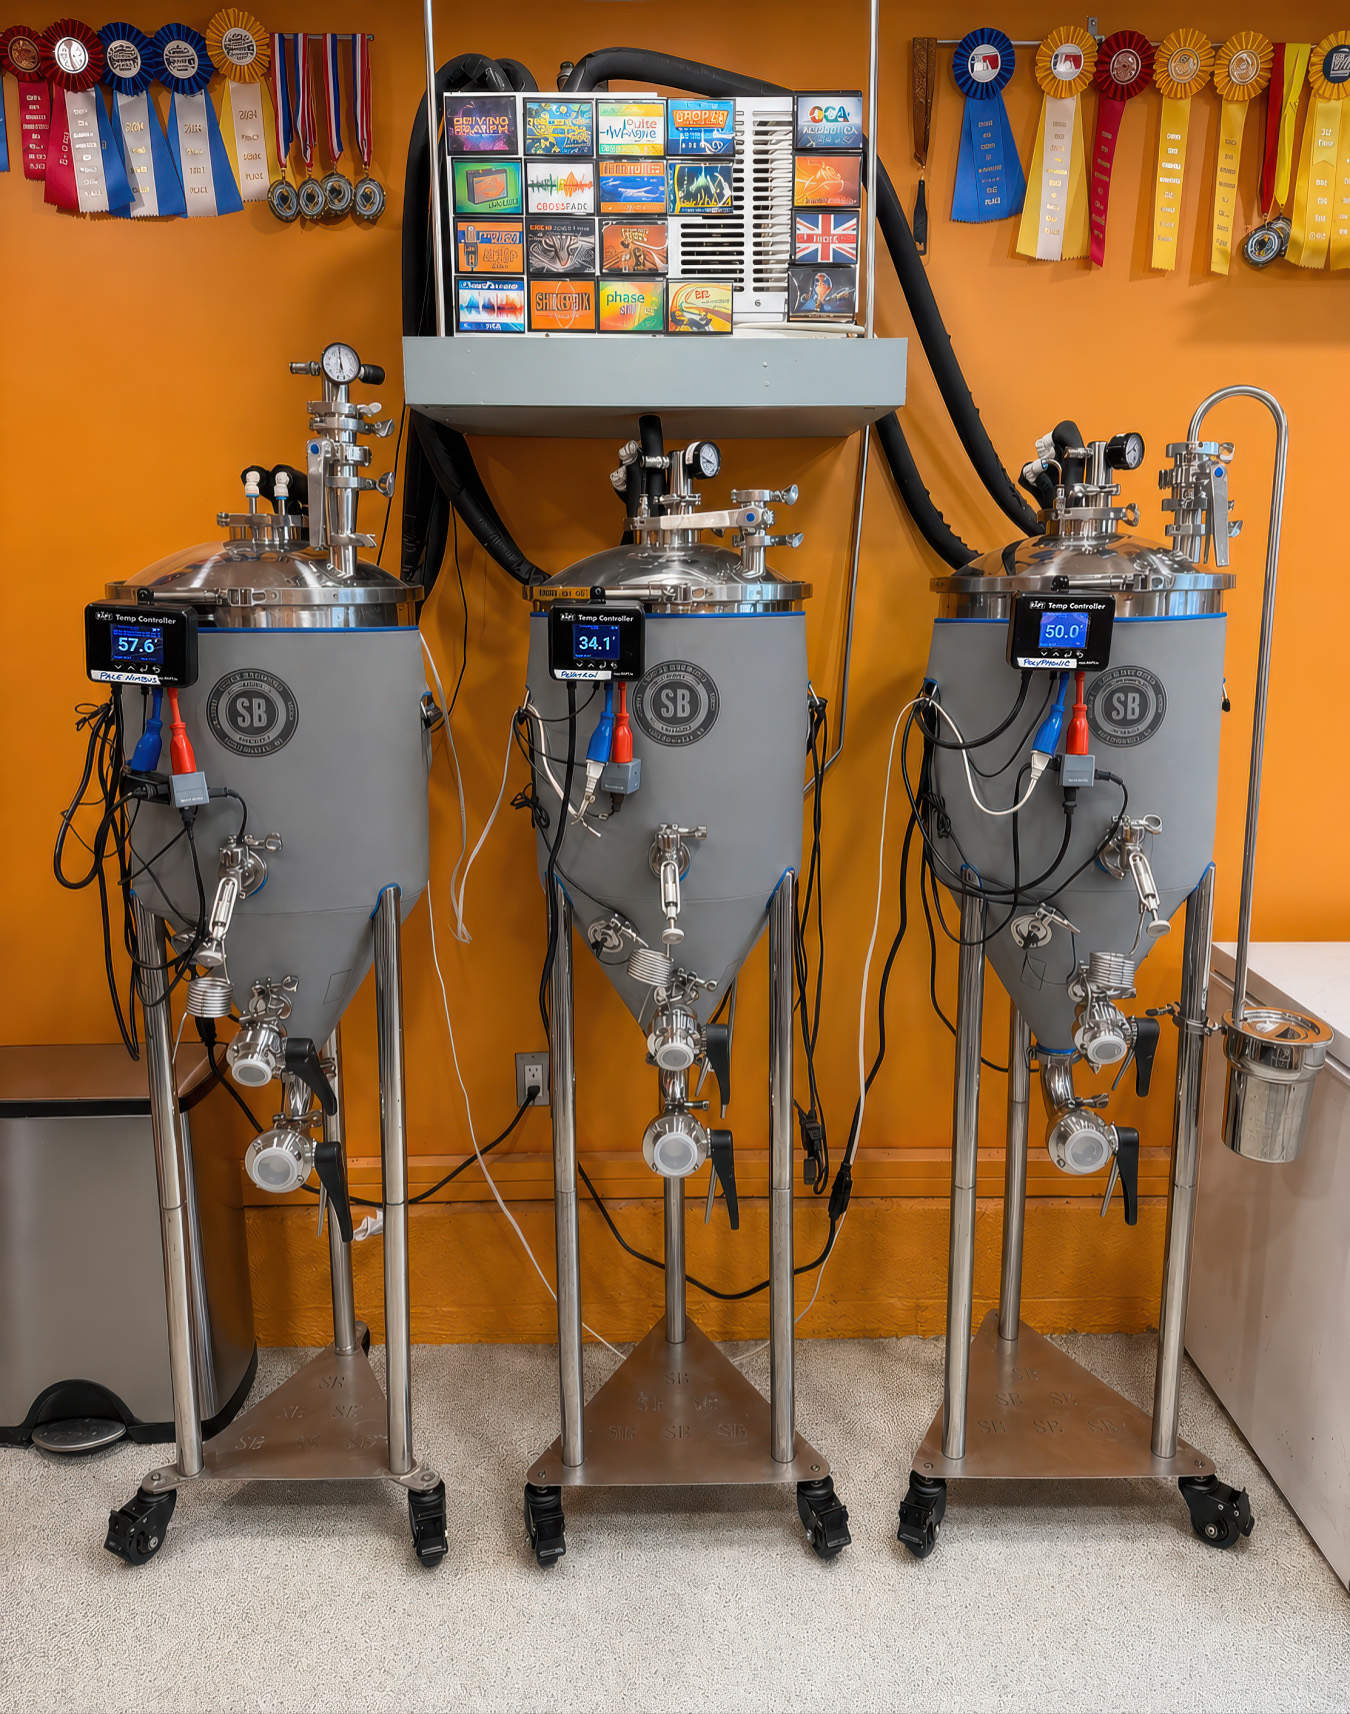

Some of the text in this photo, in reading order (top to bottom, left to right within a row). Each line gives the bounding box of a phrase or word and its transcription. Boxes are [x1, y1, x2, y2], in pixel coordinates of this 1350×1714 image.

[606, 291, 645, 306] phase
[1048, 602, 1068, 611] Temp
[1069, 602, 1106, 610] Controller
[115, 613, 137, 623] Temp
[138, 615, 177, 625] Controller
[578, 614, 598, 622] Temp
[598, 614, 634, 622] Controller
[1023, 658, 1071, 667] POLYPHONIC
[99, 671, 123, 681] PALE
[125, 672, 158, 684] NIMBUS
[661, 688, 691, 718] SB
[1111, 692, 1140, 720] SB
[236, 697, 268, 728] SB
